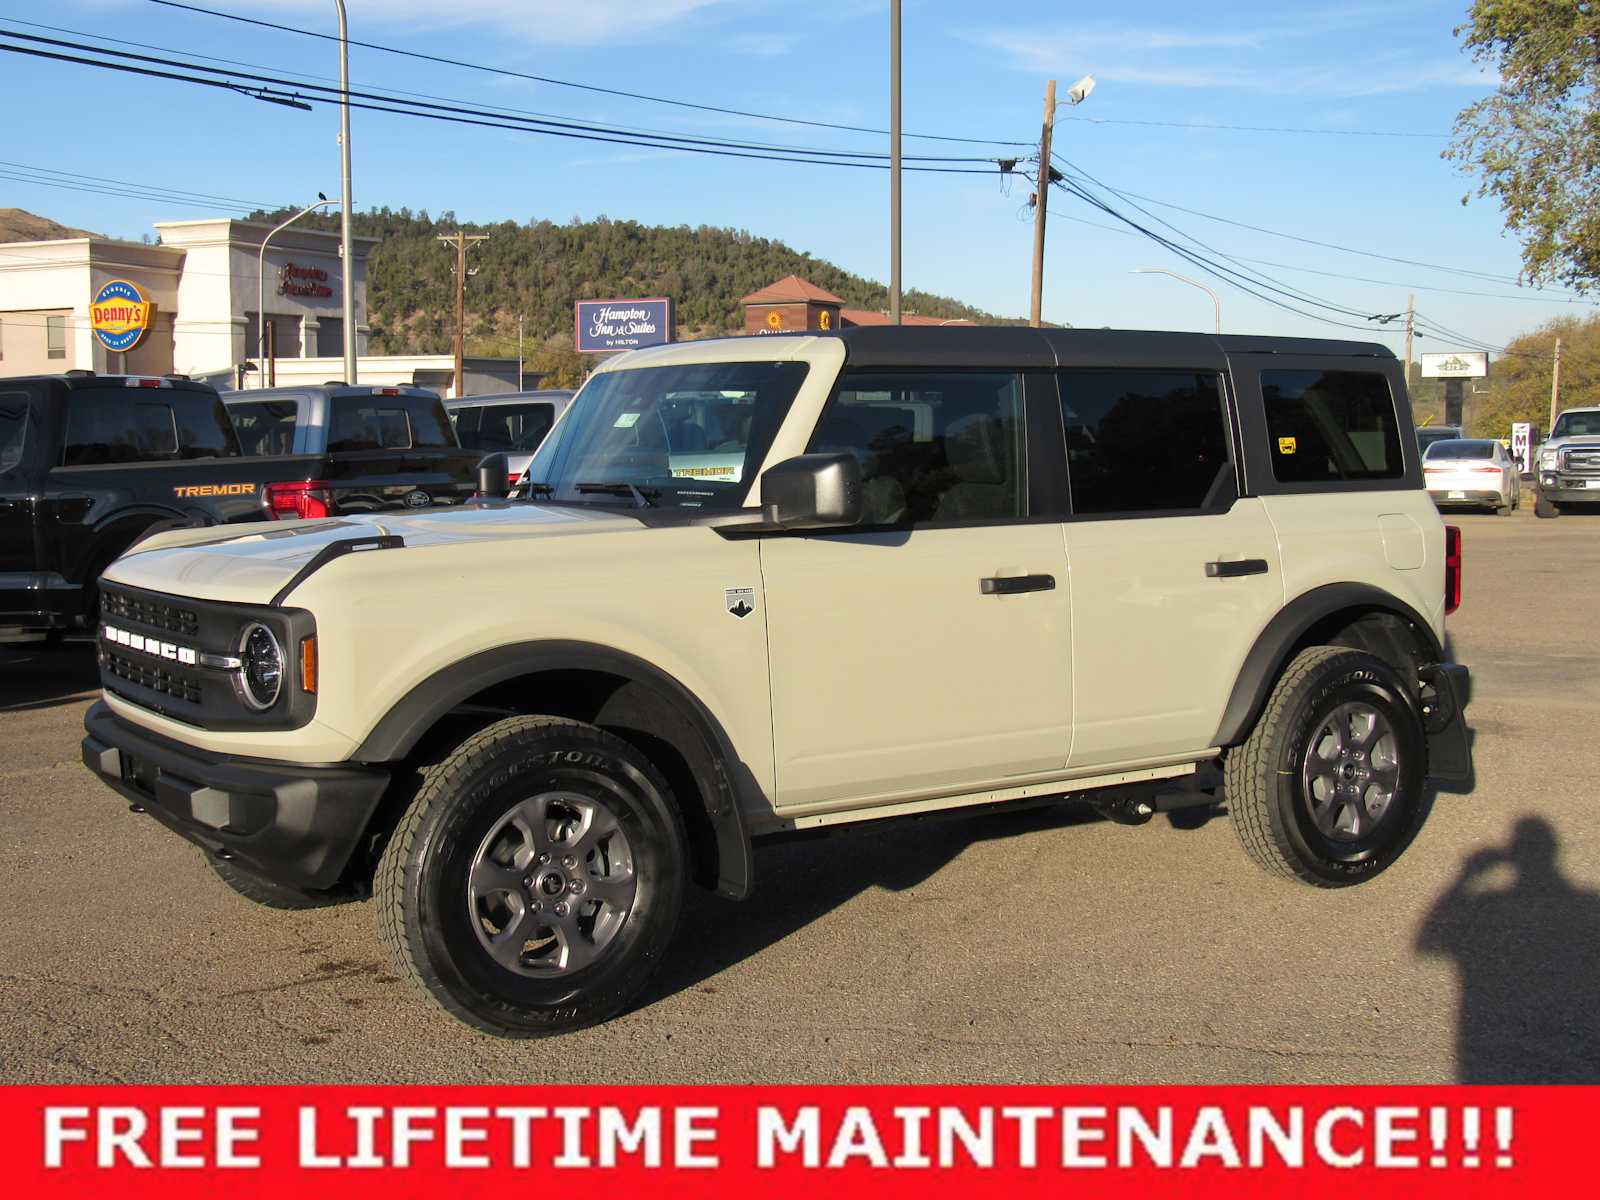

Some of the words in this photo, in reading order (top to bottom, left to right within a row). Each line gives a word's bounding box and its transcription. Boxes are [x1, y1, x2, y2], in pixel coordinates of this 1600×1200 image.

[93, 304, 141, 324] Denny's
[593, 307, 651, 324] Hampton
[590, 322, 618, 337] Inn
[618, 327, 625, 335] &
[625, 321, 656, 335] Suites
[673, 466, 736, 477] TREMOR
[174, 483, 256, 497] TREMOR
